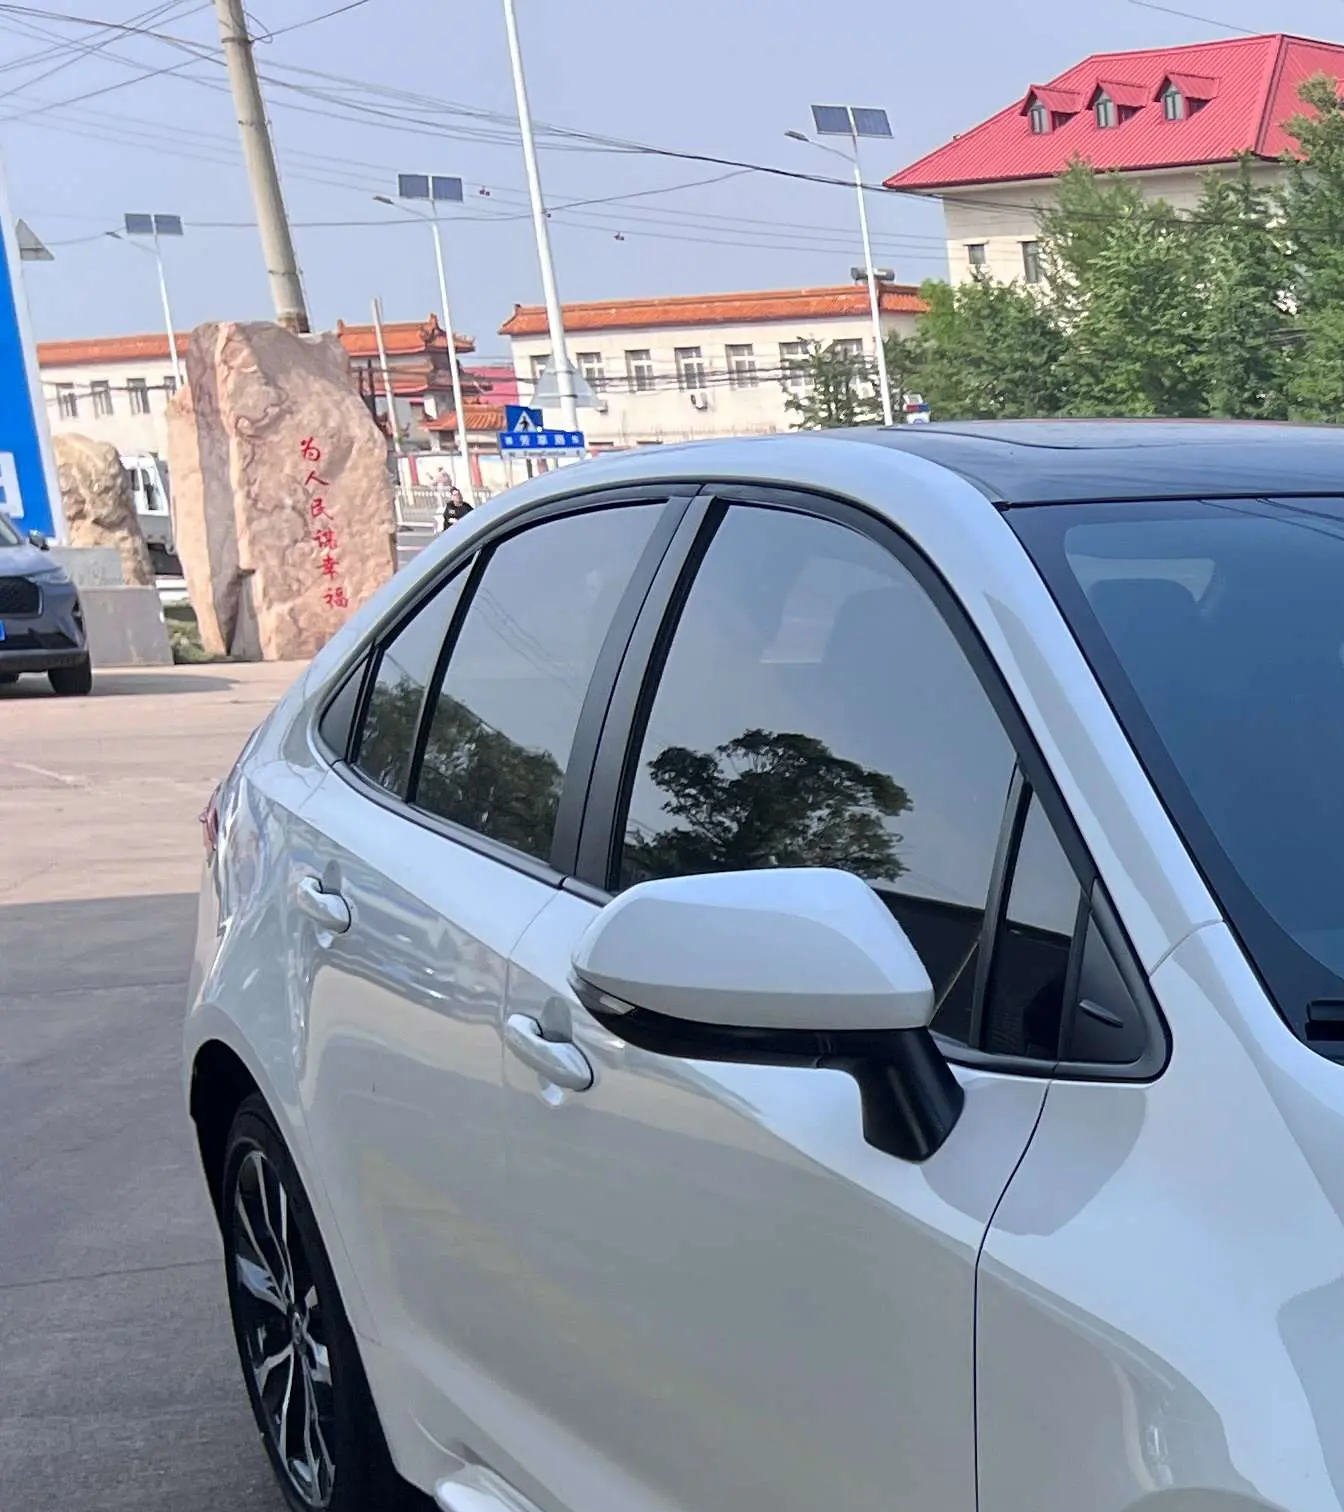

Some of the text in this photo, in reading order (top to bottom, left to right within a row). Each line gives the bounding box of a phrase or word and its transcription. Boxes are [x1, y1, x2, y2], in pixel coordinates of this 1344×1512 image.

[300, 436, 348, 609] 为人民谋幸福
